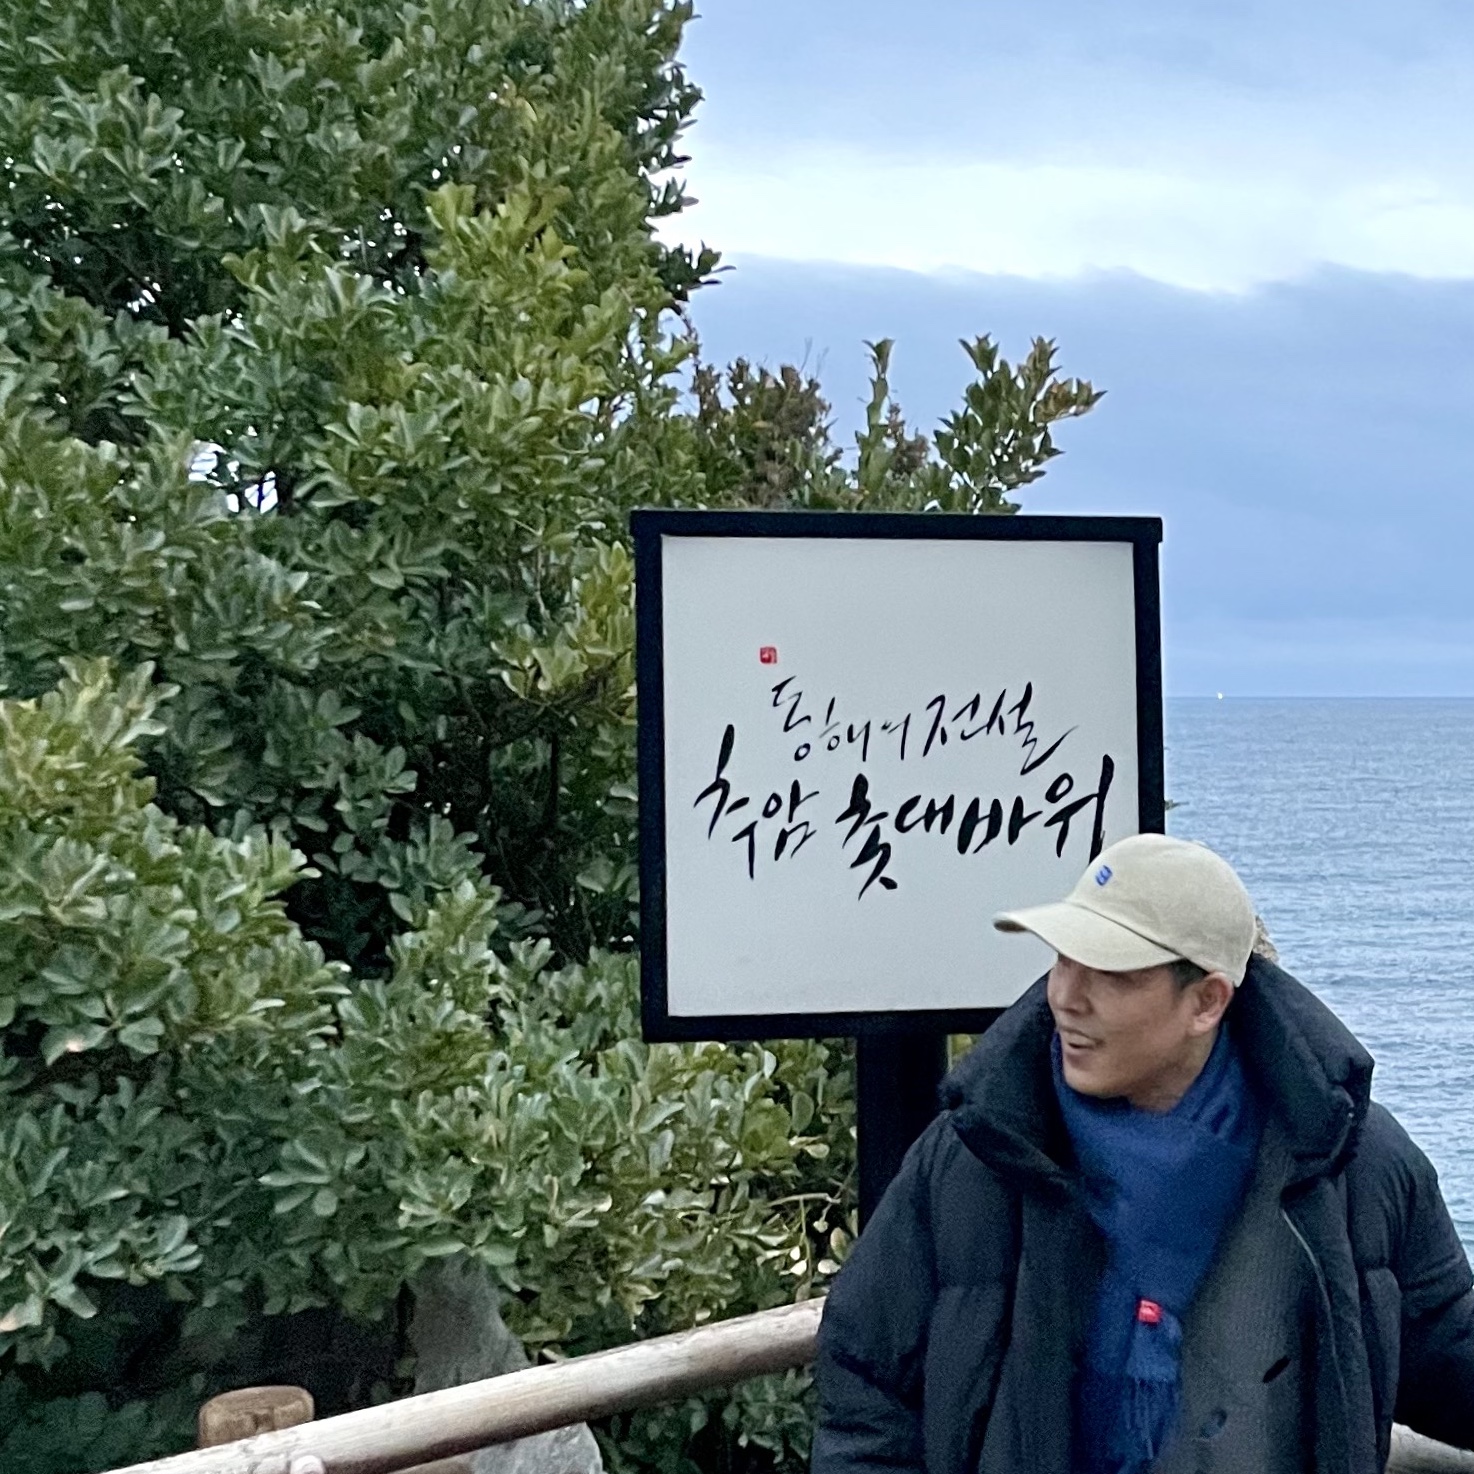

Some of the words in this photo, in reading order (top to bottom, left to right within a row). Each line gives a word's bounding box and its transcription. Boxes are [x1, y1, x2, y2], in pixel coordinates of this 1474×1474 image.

[921, 681, 1079, 776] 전설
[693, 723, 819, 881] 추암
[835, 753, 1115, 901] 촛대바위
